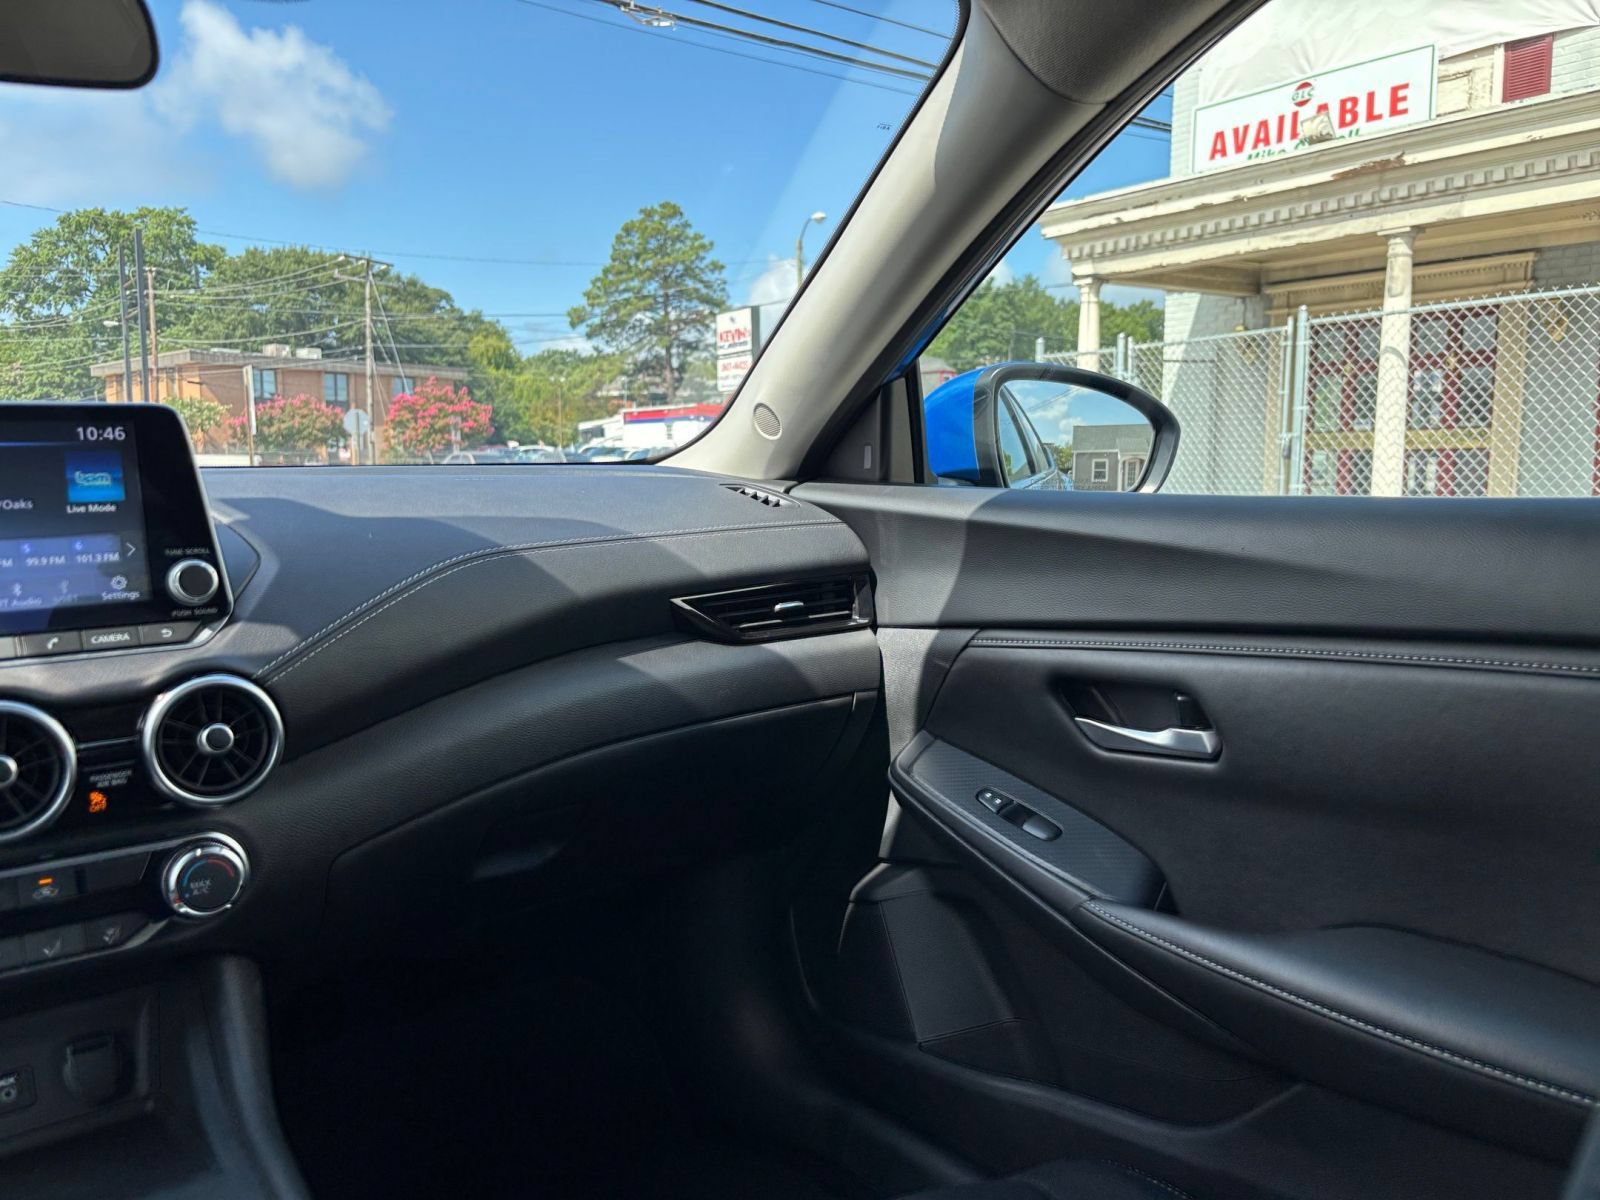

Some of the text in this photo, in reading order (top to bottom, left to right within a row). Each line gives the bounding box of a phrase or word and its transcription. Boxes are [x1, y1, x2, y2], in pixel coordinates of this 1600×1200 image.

[76, 427, 126, 441] 10:46
[66, 503, 117, 513] Live Mode
[49, 555, 66, 564] FM
[103, 551, 120, 561] FM
[101, 591, 140, 601] Settings
[90, 631, 130, 643] CAMERA
